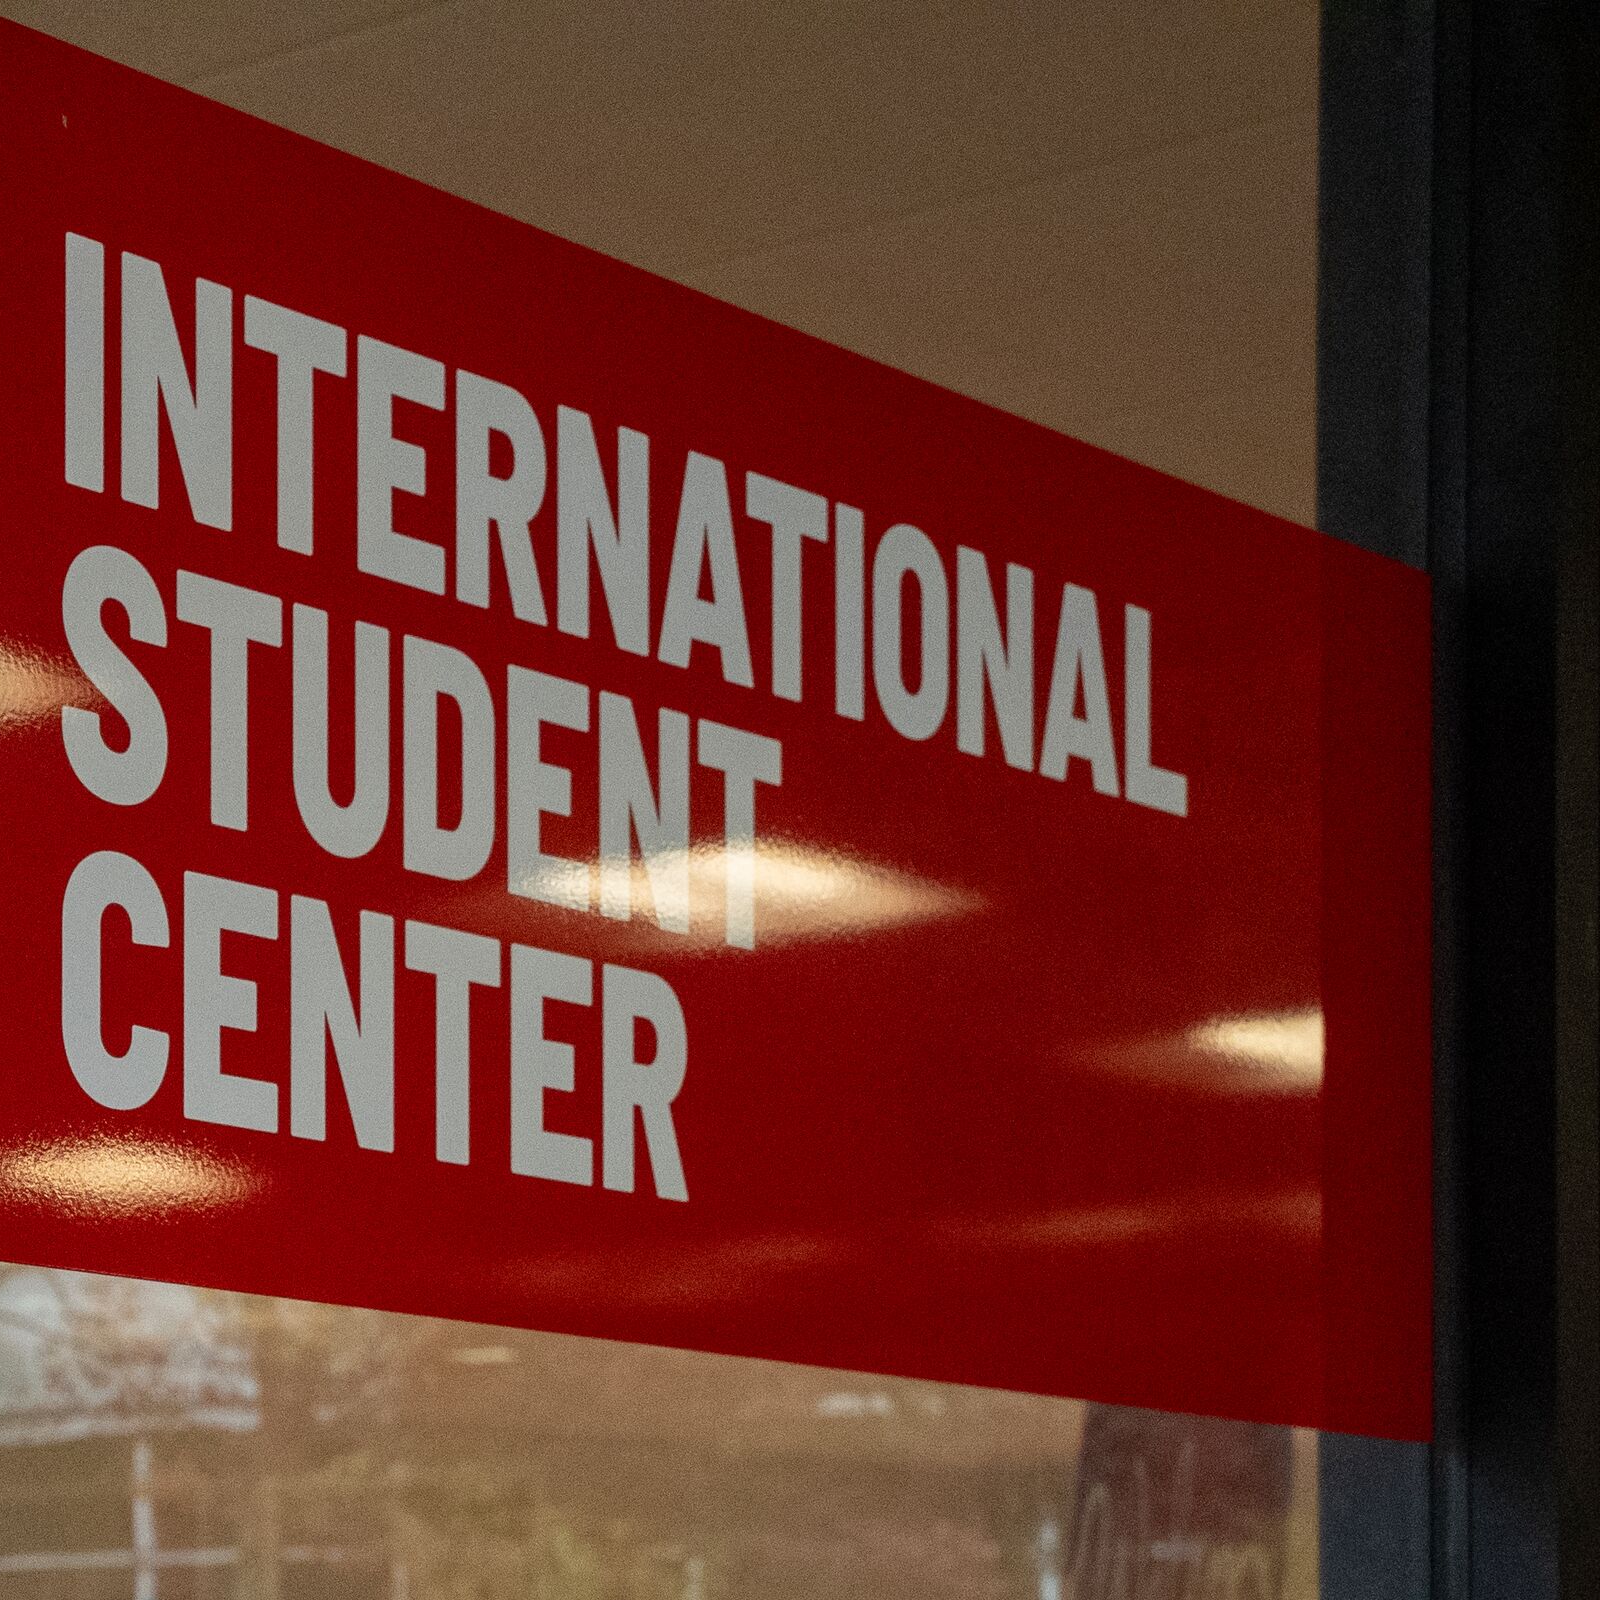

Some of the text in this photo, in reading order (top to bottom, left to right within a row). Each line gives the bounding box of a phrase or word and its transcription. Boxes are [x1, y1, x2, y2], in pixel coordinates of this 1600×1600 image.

[65, 232, 1187, 816] INTERNATIONAL
[62, 546, 782, 950] STUDENT
[62, 851, 688, 1202] CENTER
